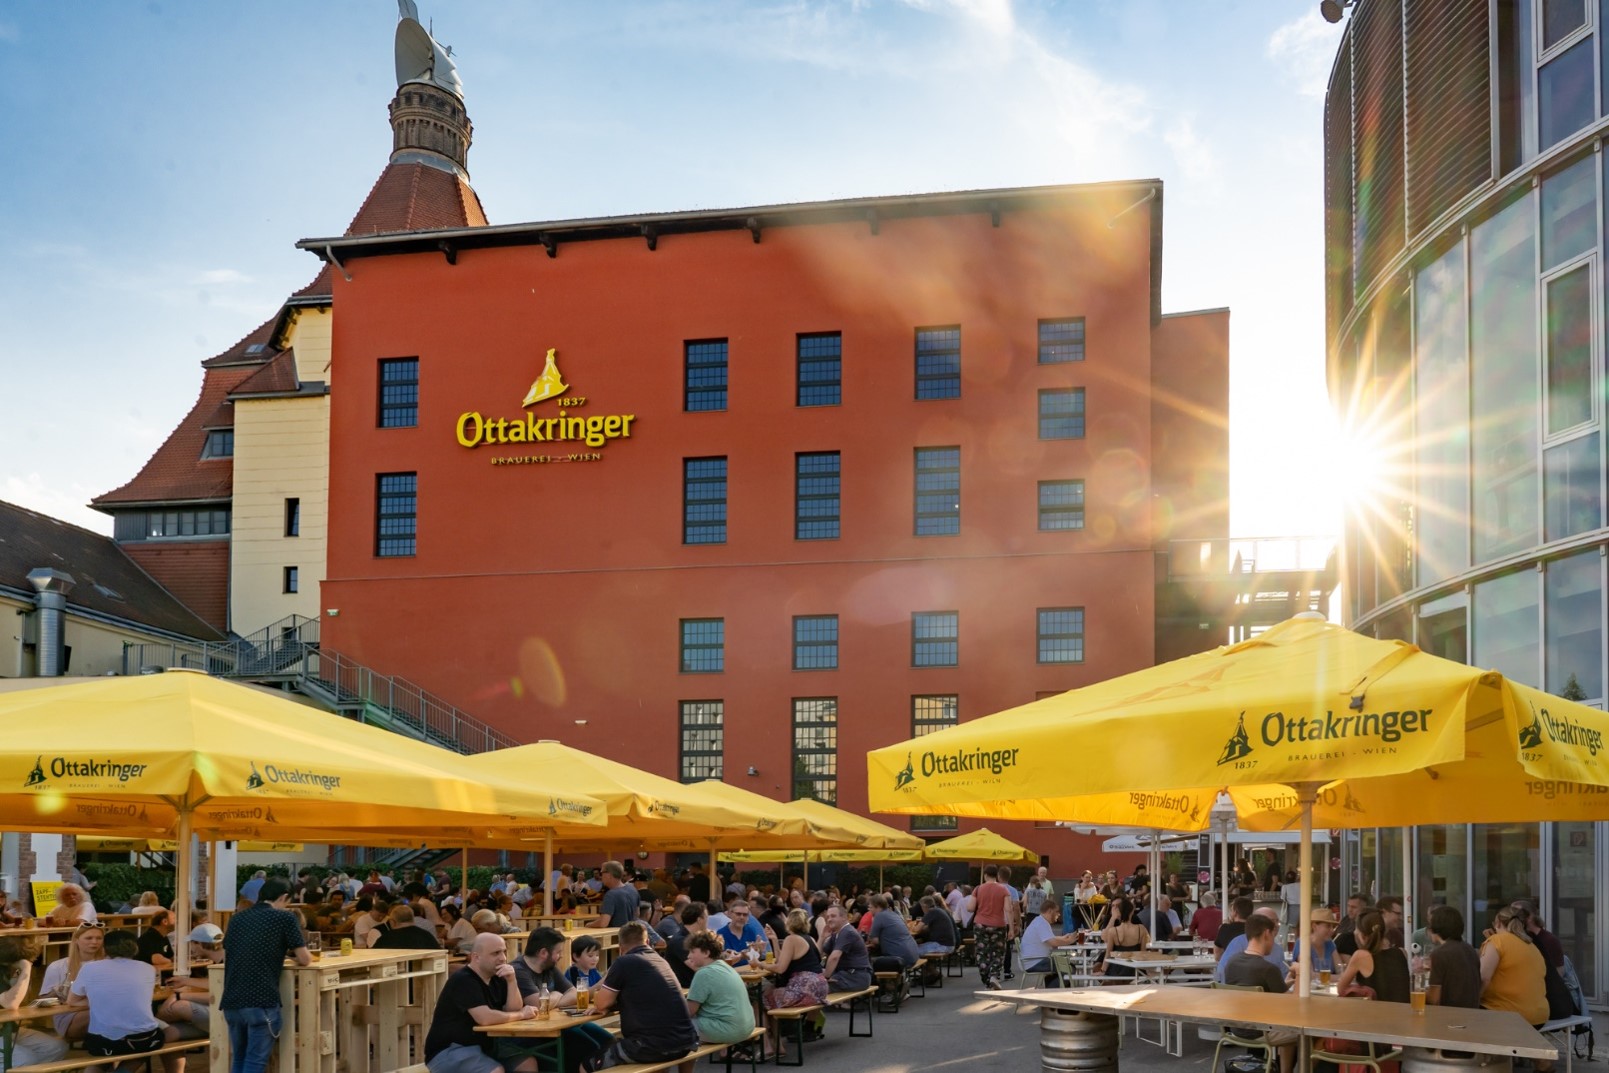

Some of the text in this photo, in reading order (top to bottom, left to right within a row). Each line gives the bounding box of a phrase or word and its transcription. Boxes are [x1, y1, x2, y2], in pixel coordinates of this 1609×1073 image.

[557, 397, 586, 407] 1837
[456, 411, 635, 448] Ottakringer
[491, 453, 601, 465] BRAUEREI WIEN
[1261, 709, 1433, 747] Ottakringer
[1541, 708, 1604, 756] Ottakringer
[921, 747, 1019, 777] Ottakringer
[1234, 760, 1258, 770] 1837
[1288, 752, 1345, 762] BRAUEREI
[1362, 747, 1397, 755] WIEN
[1521, 752, 1543, 761] 1837
[51, 757, 148, 781] Ottakringer
[264, 764, 341, 790] Ottakringer
